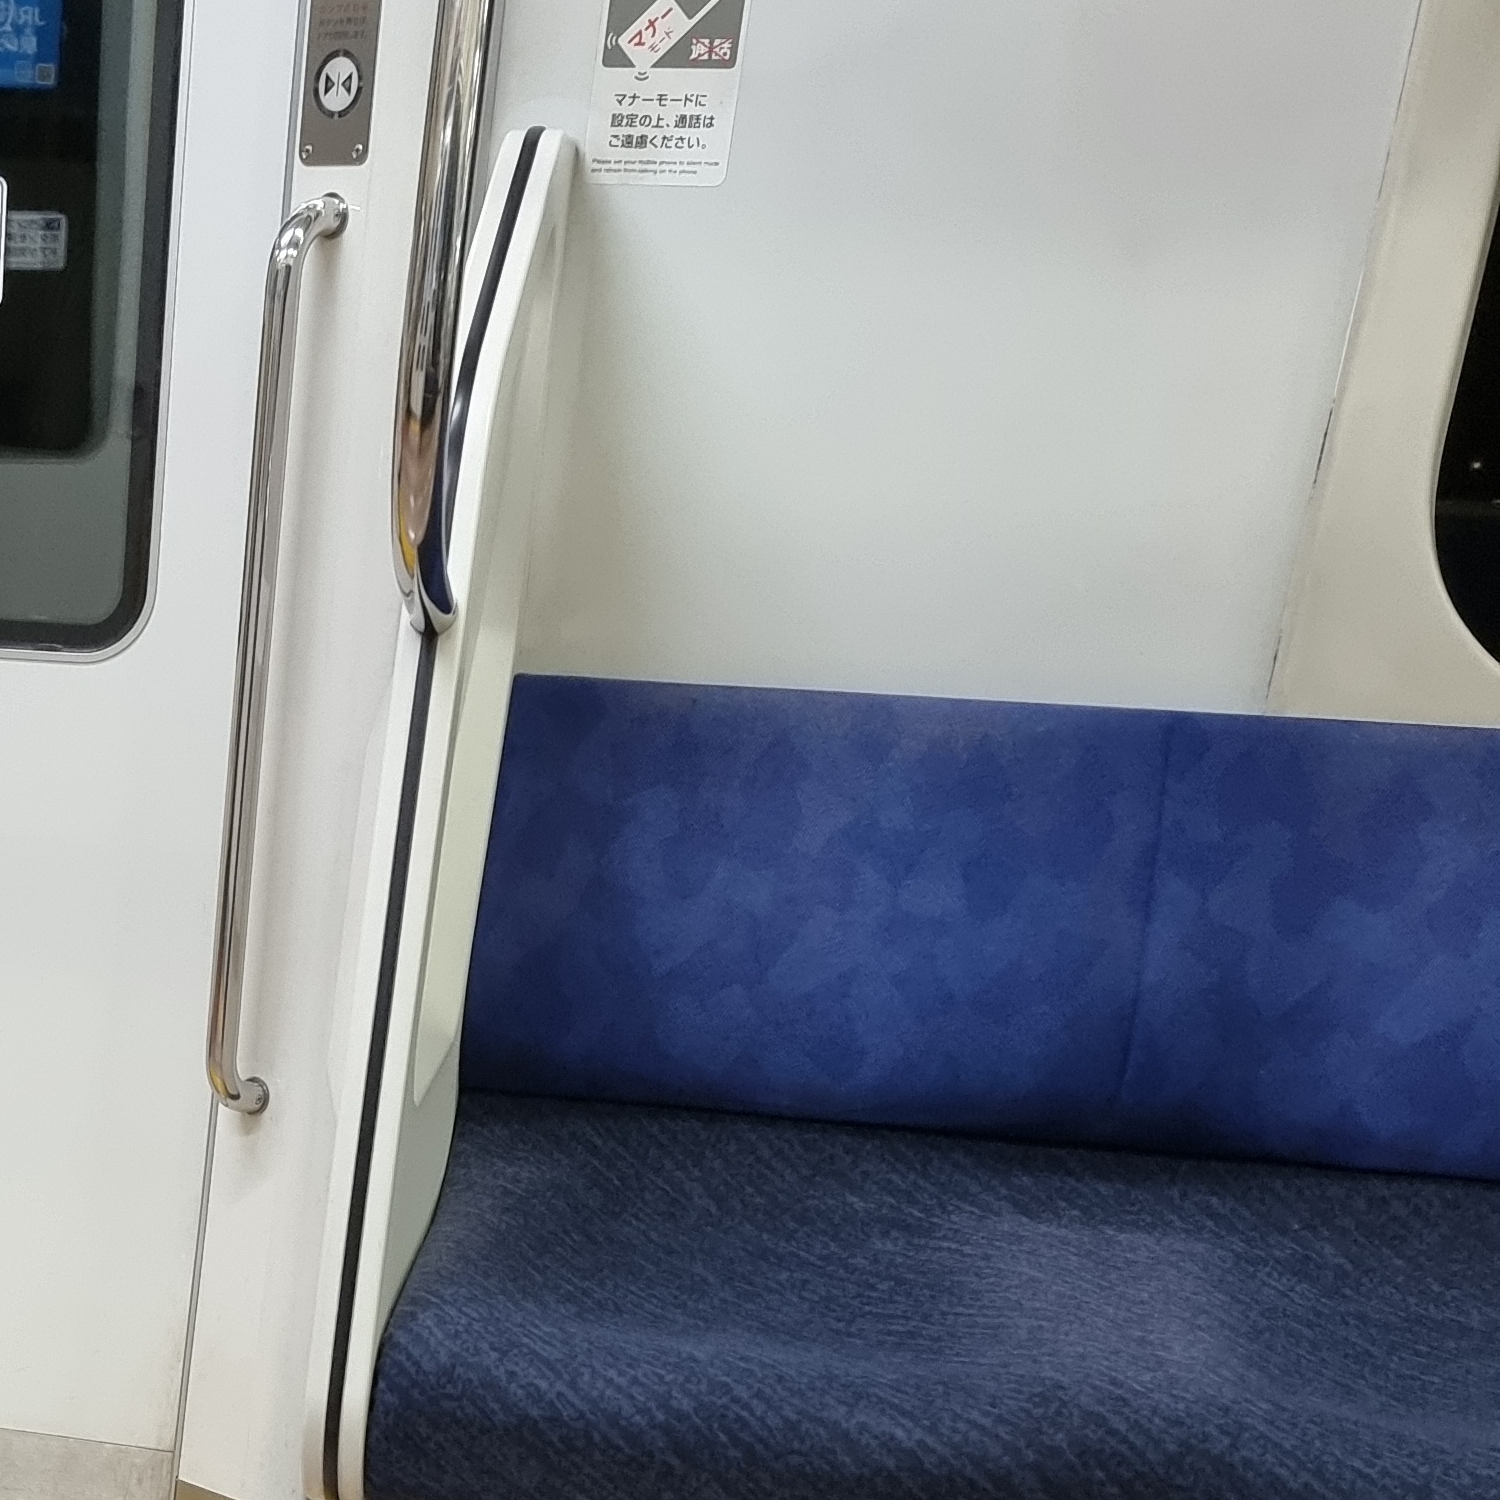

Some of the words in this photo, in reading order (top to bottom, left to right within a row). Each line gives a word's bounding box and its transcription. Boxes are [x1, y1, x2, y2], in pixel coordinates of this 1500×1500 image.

[627, 6, 674, 47] マナー
[647, 27, 675, 54] モード
[613, 93, 708, 108] マナーモードに
[610, 113, 715, 129] 設定の上、通話は
[608, 134, 707, 150] ご遠慮ください。
